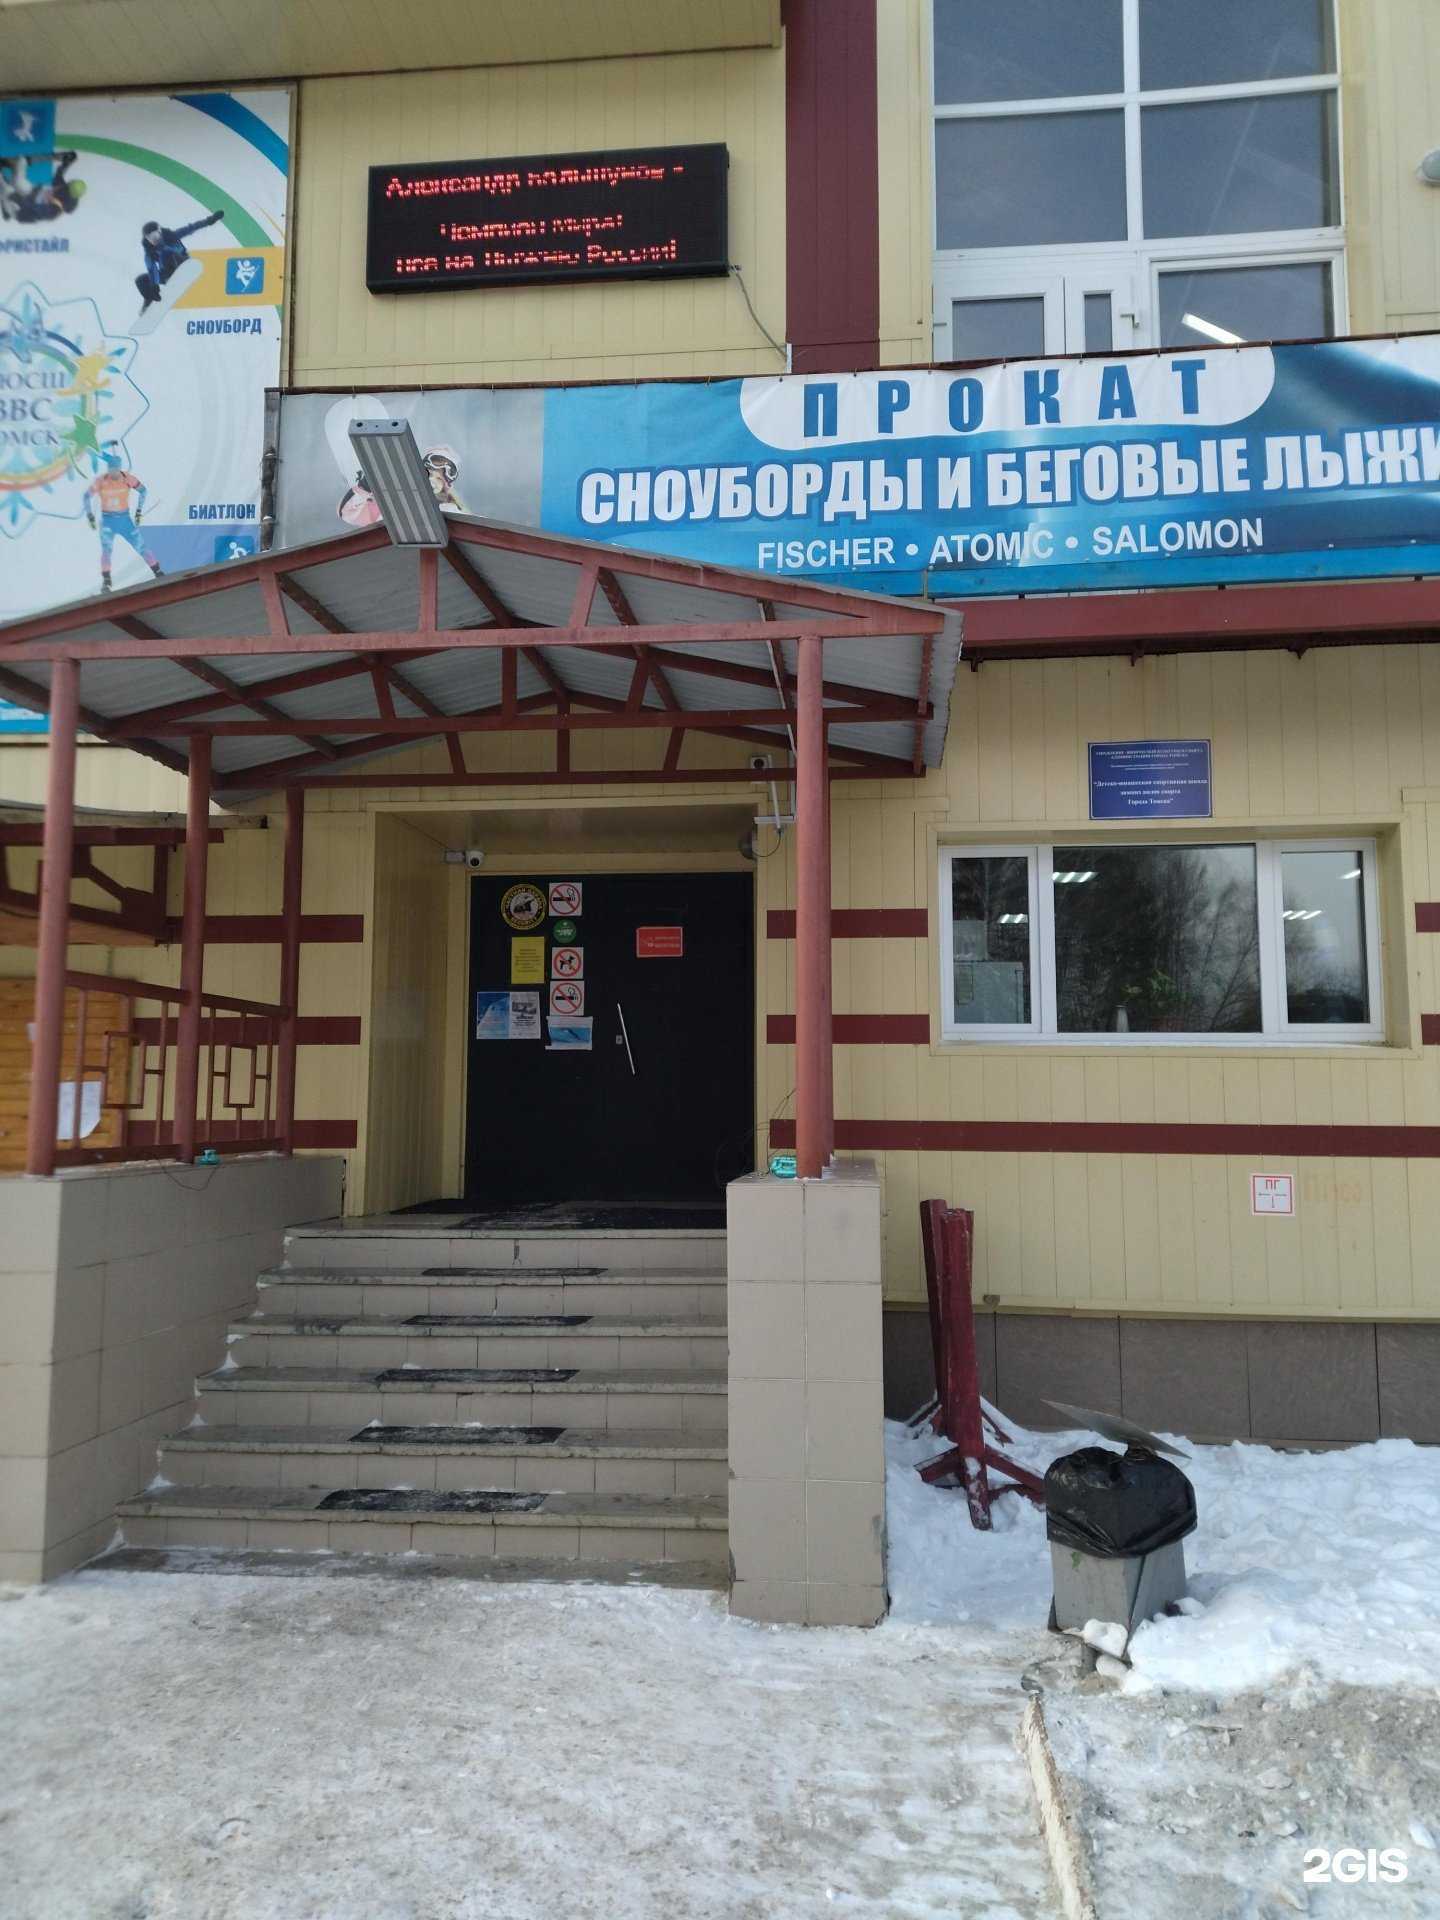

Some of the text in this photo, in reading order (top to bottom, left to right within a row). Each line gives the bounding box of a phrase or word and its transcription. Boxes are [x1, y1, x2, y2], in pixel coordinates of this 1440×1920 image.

[186, 318, 262, 336] СНОУБОРД
[802, 358, 1207, 439] ПРОКАТ
[580, 426, 1440, 525] СНОУБОРДЫ И БЕГОВЫЕ ЛЫЖИ
[188, 503, 256, 521] БИАТЛОН
[757, 517, 1264, 570] FISCHER ATOMIC SALOMON
[1265, 1179, 1280, 1190] ПГ
